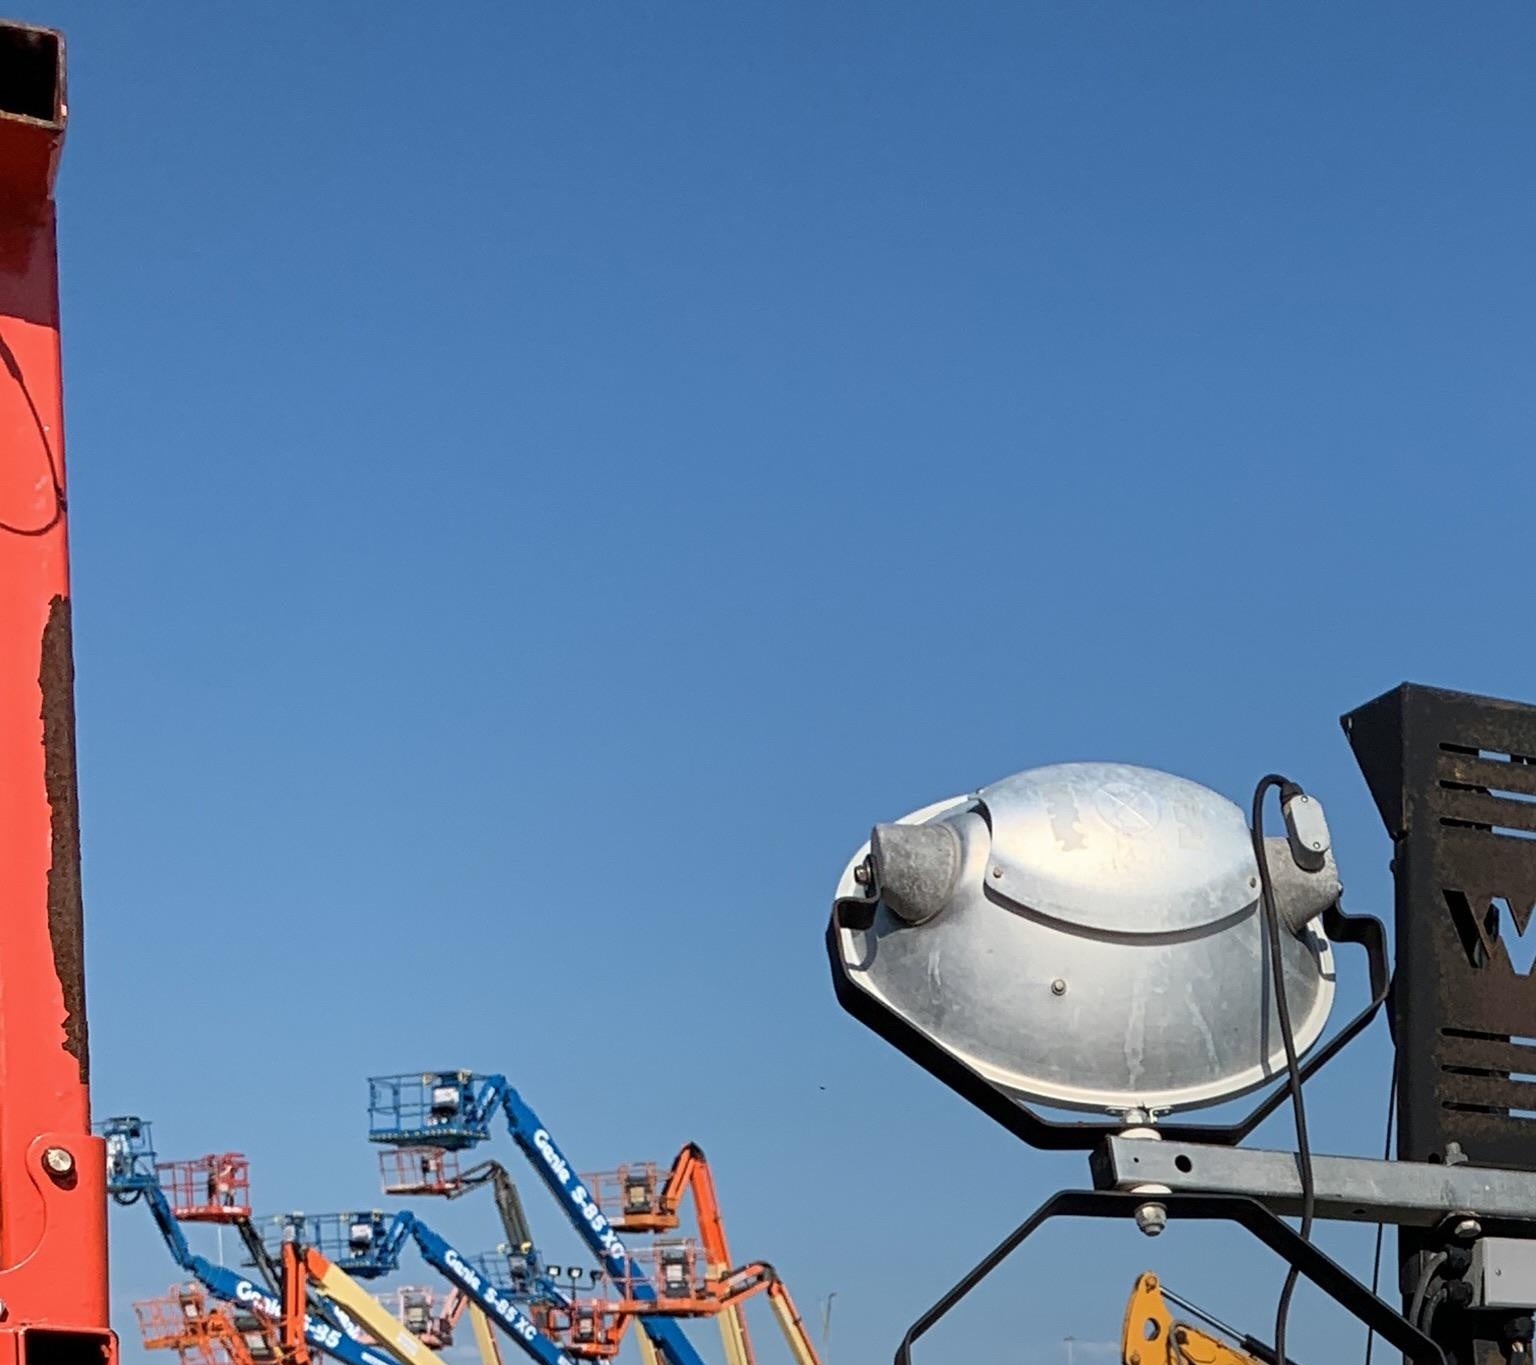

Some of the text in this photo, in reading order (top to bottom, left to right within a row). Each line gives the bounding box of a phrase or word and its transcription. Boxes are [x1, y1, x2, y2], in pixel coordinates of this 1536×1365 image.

[533, 1128, 571, 1184] Genie
[571, 1185, 608, 1232] S-85
[444, 1249, 538, 1342] Genie S-85 XC
